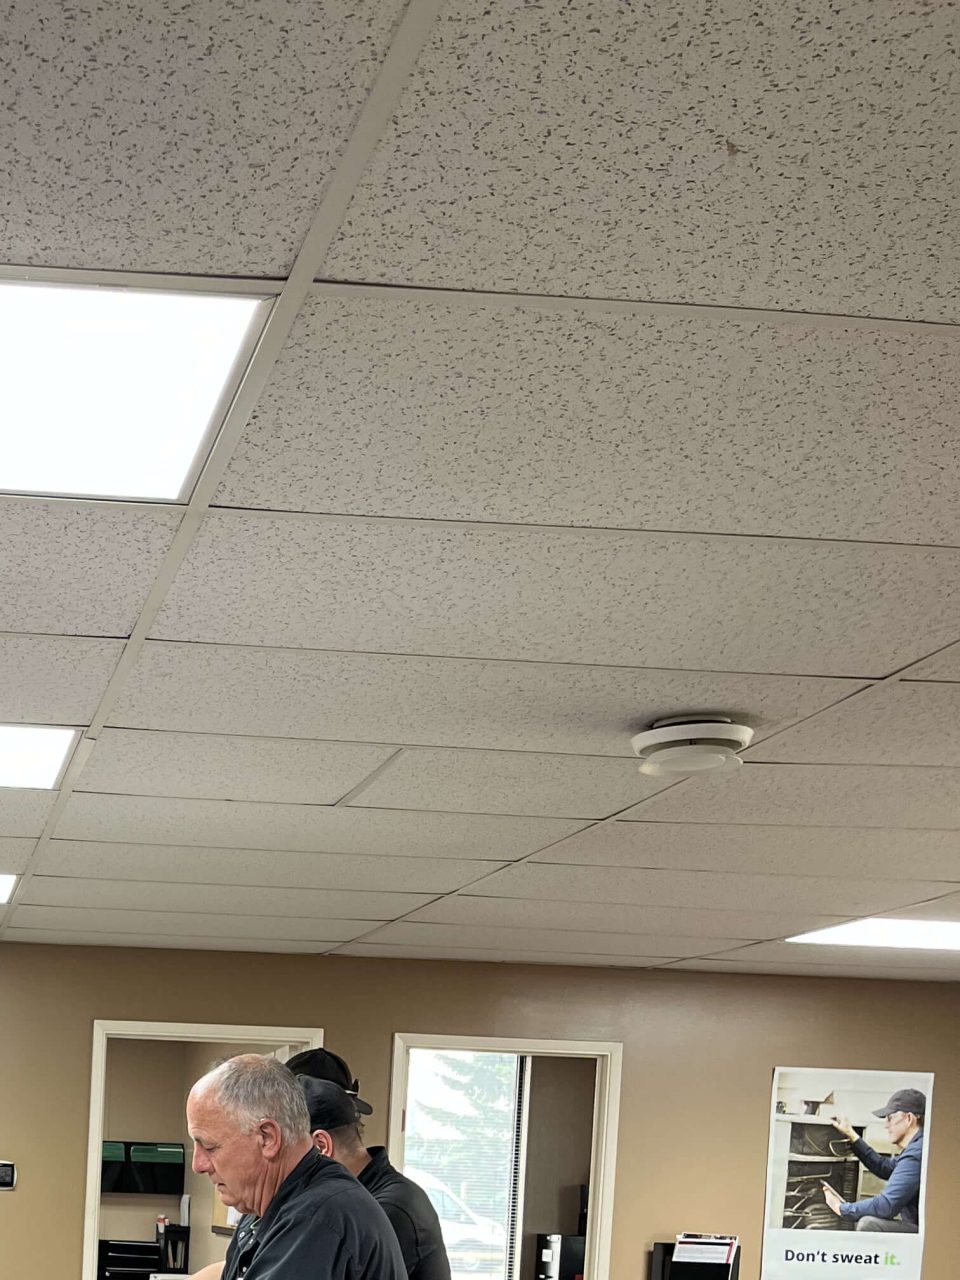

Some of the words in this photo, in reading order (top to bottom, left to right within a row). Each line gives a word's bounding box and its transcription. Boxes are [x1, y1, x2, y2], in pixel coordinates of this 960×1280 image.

[784, 1249, 828, 1263] Don't
[832, 1252, 880, 1265] sweat
[884, 1251, 901, 1266] it.
